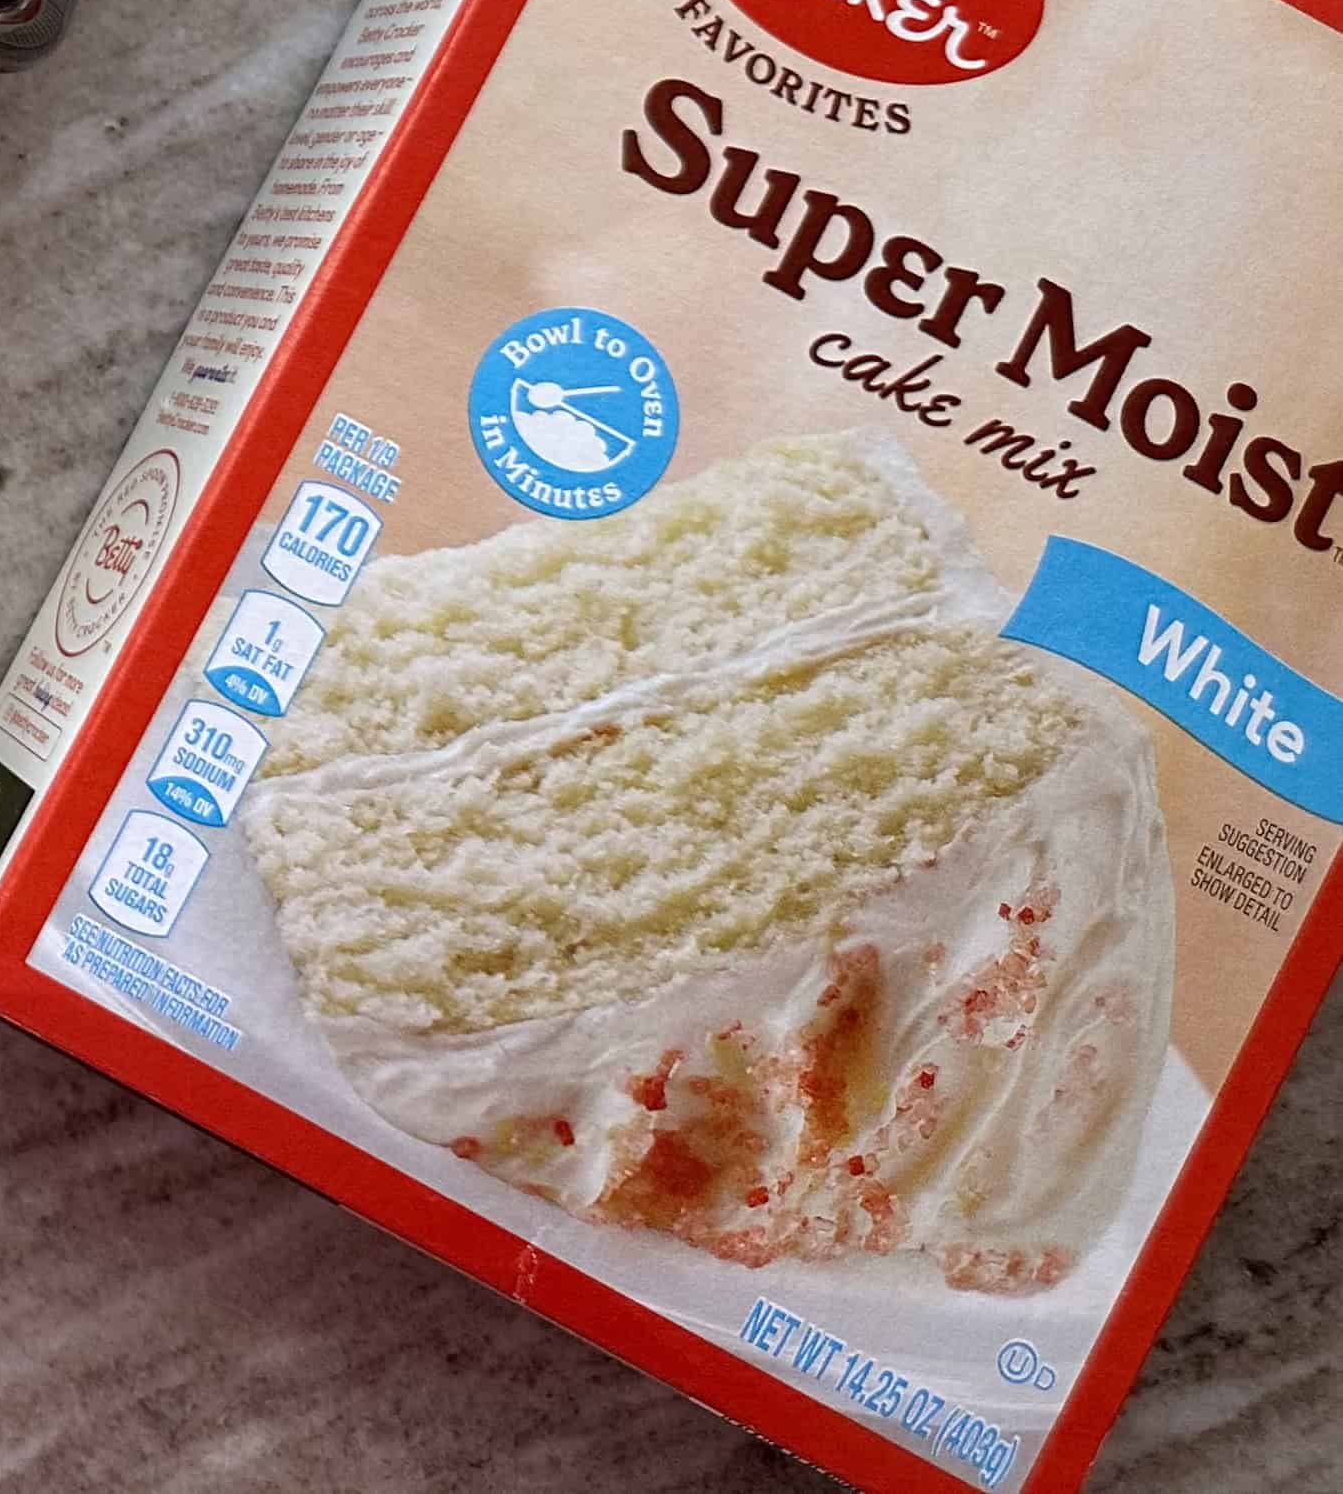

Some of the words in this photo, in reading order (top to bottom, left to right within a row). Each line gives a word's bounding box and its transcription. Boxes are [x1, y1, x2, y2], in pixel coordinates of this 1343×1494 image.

[499, 317, 584, 369] Bowl
[594, 327, 626, 358] to
[629, 356, 663, 438] Oven
[327, 415, 370, 452] PER
[368, 436, 398, 468] 1/9
[807, 332, 963, 430] cake
[964, 416, 1099, 501] mix
[315, 442, 401, 504] PACKAGE
[480, 414, 507, 449] in
[494, 446, 623, 509] Minutes
[94, 524, 144, 587] Betty
[299, 493, 370, 558] 170
[278, 531, 353, 583] CALORIES
[230, 637, 264, 664] SAT
[262, 655, 295, 682] FAT
[1136, 602, 1306, 765] White
[248, 685, 269, 705] DV
[172, 746, 236, 793] SODIUM
[193, 797, 215, 818] DV
[1217, 823, 1307, 885] SUGGESTION
[1255, 818, 1317, 864] SERVING
[104, 877, 168, 924] SUGARS
[123, 860, 170, 900] TOTAL
[1190, 867, 1236, 904] SHOW
[1232, 892, 1281, 932] DETAIL
[1196, 845, 1273, 899] ENLARGED
[1272, 886, 1294, 911] TO
[69, 916, 100, 946] SEE
[96, 925, 165, 980] NUTRITION
[161, 965, 202, 1001] FACTS
[199, 985, 231, 1018] FOR
[151, 989, 241, 1052] INFORMATION
[740, 1299, 801, 1356] NET
[792, 1326, 843, 1380] WT
[836, 1353, 909, 1417] 14.25
[902, 1388, 945, 1438] OZ
[930, 1407, 1018, 1489] (403g)
